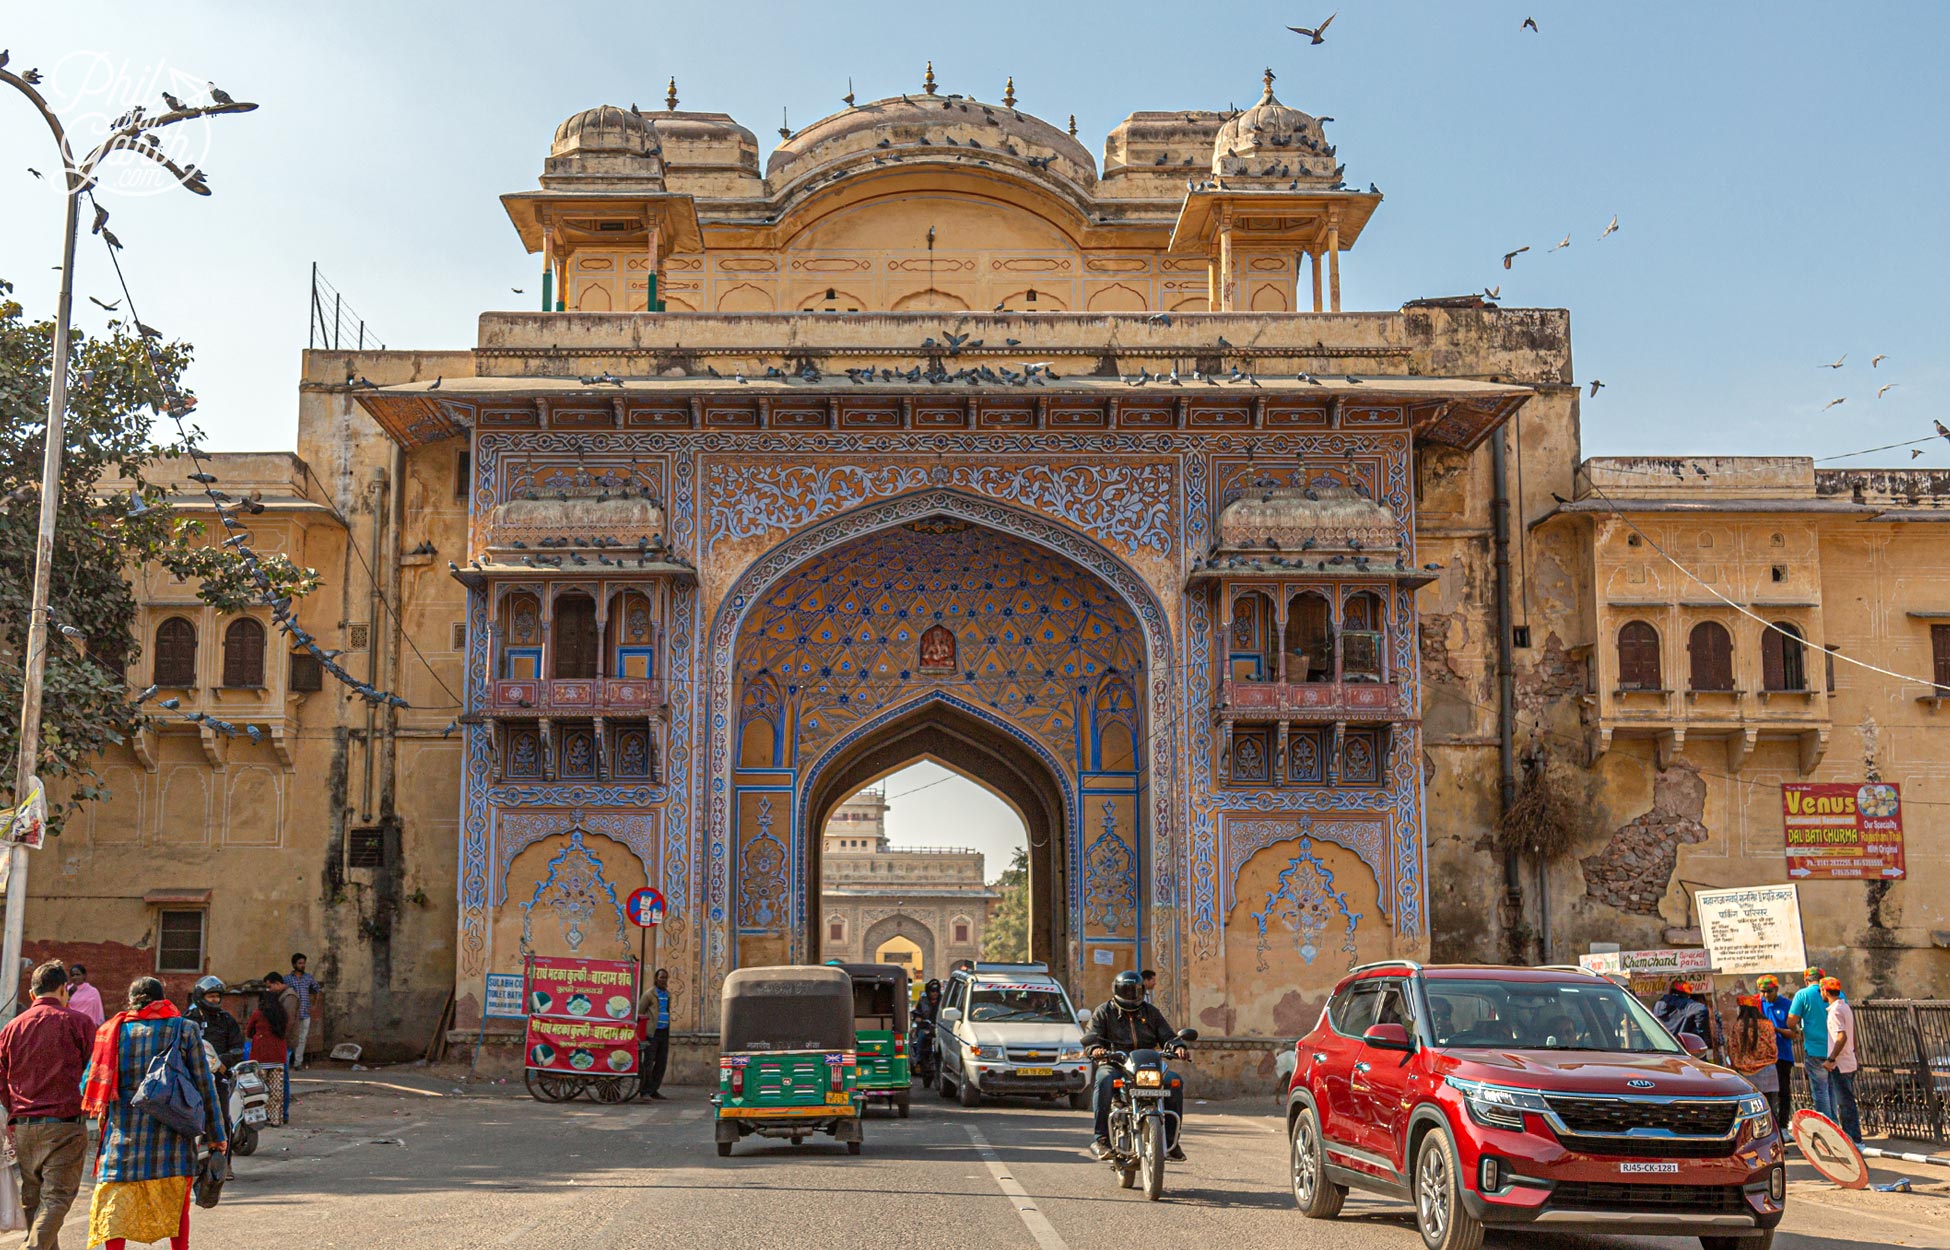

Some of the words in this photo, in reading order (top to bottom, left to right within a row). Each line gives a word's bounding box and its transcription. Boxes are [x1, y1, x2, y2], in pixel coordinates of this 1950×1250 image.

[1785, 791, 1856, 815] Venus
[1863, 820, 1873, 829] Our
[1788, 829, 1804, 844] DAL
[1805, 829, 1823, 844] BATI
[1823, 829, 1858, 845] CHURMA
[488, 977, 513, 988] SULABH
[548, 968, 567, 981] मटका
[591, 970, 617, 985] बादाम
[552, 1023, 570, 1036] मटका
[594, 1026, 618, 1039] बादाम
[1622, 1164, 1677, 1172] RJ45-CK-1281
